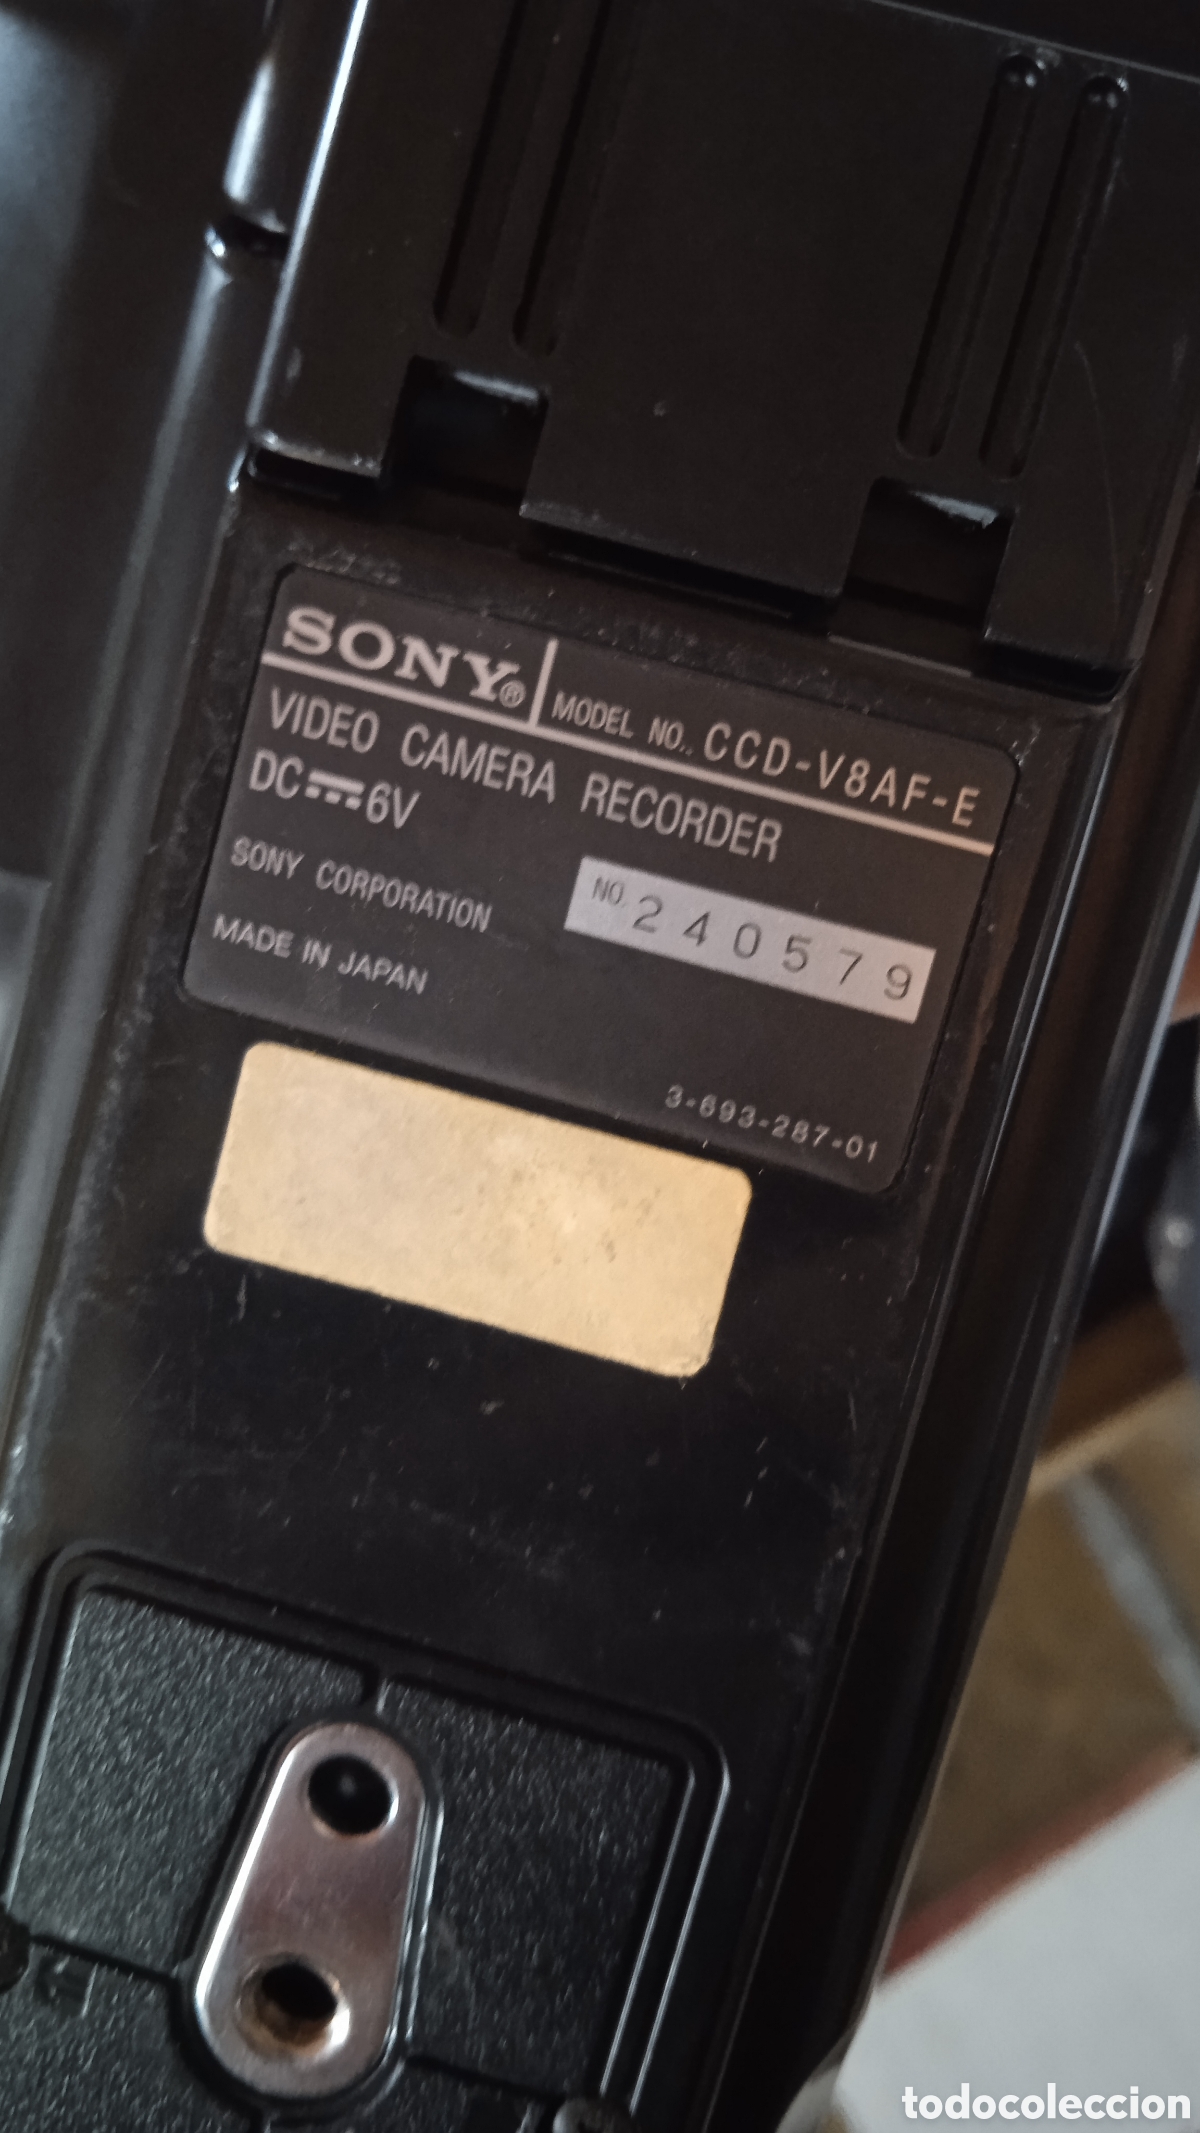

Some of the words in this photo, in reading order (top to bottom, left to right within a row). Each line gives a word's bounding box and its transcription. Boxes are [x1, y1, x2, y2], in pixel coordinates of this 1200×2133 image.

[268, 688, 380, 754] VIDEO
[401, 723, 557, 804] CAMERA
[581, 772, 783, 862] RECORDER
[551, 691, 634, 739] MODEL
[703, 722, 980, 828] CCD-V8AF-E
[230, 836, 305, 879] SONY
[316, 860, 493, 933] CORPORATION
[212, 914, 293, 957] MADE
[302, 942, 331, 969] IN
[338, 951, 429, 995] JAPAN
[665, 1084, 879, 1163] 3-693-287-01
